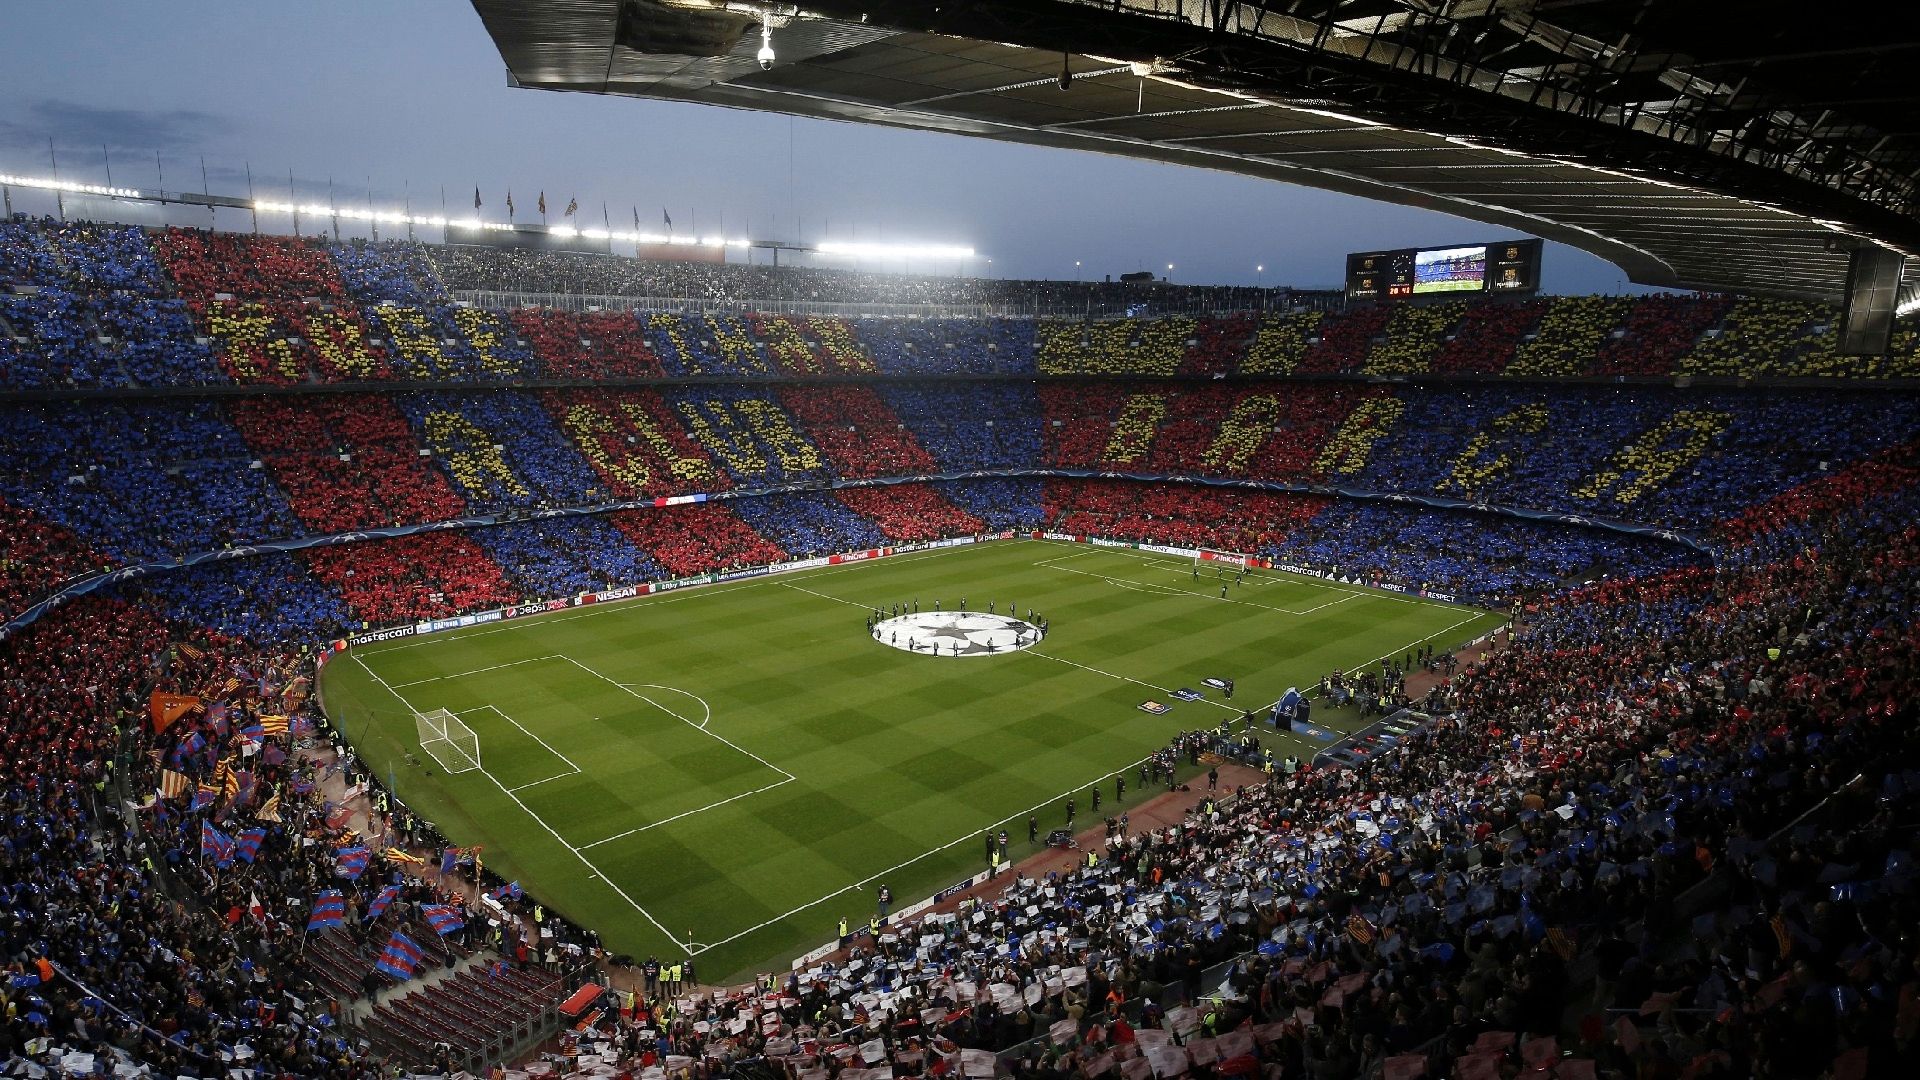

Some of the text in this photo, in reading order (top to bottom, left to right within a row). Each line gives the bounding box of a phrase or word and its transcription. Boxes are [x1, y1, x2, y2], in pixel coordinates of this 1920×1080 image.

[424, 399, 822, 497] A CLUB
[1043, 532, 1076, 542] NISSAN
[1092, 538, 1125, 548] Heineken
[844, 552, 868, 561] UniCredit
[771, 563, 794, 572] SONY
[1274, 563, 1321, 578] mastercard
[730, 570, 753, 578] CHAMPIONS
[1380, 583, 1406, 592] RESPECT
[596, 588, 636, 603] NISSAN
[1428, 592, 1455, 602] RESPECT
[520, 602, 546, 616] pepsi
[351, 626, 414, 646] mastercard
